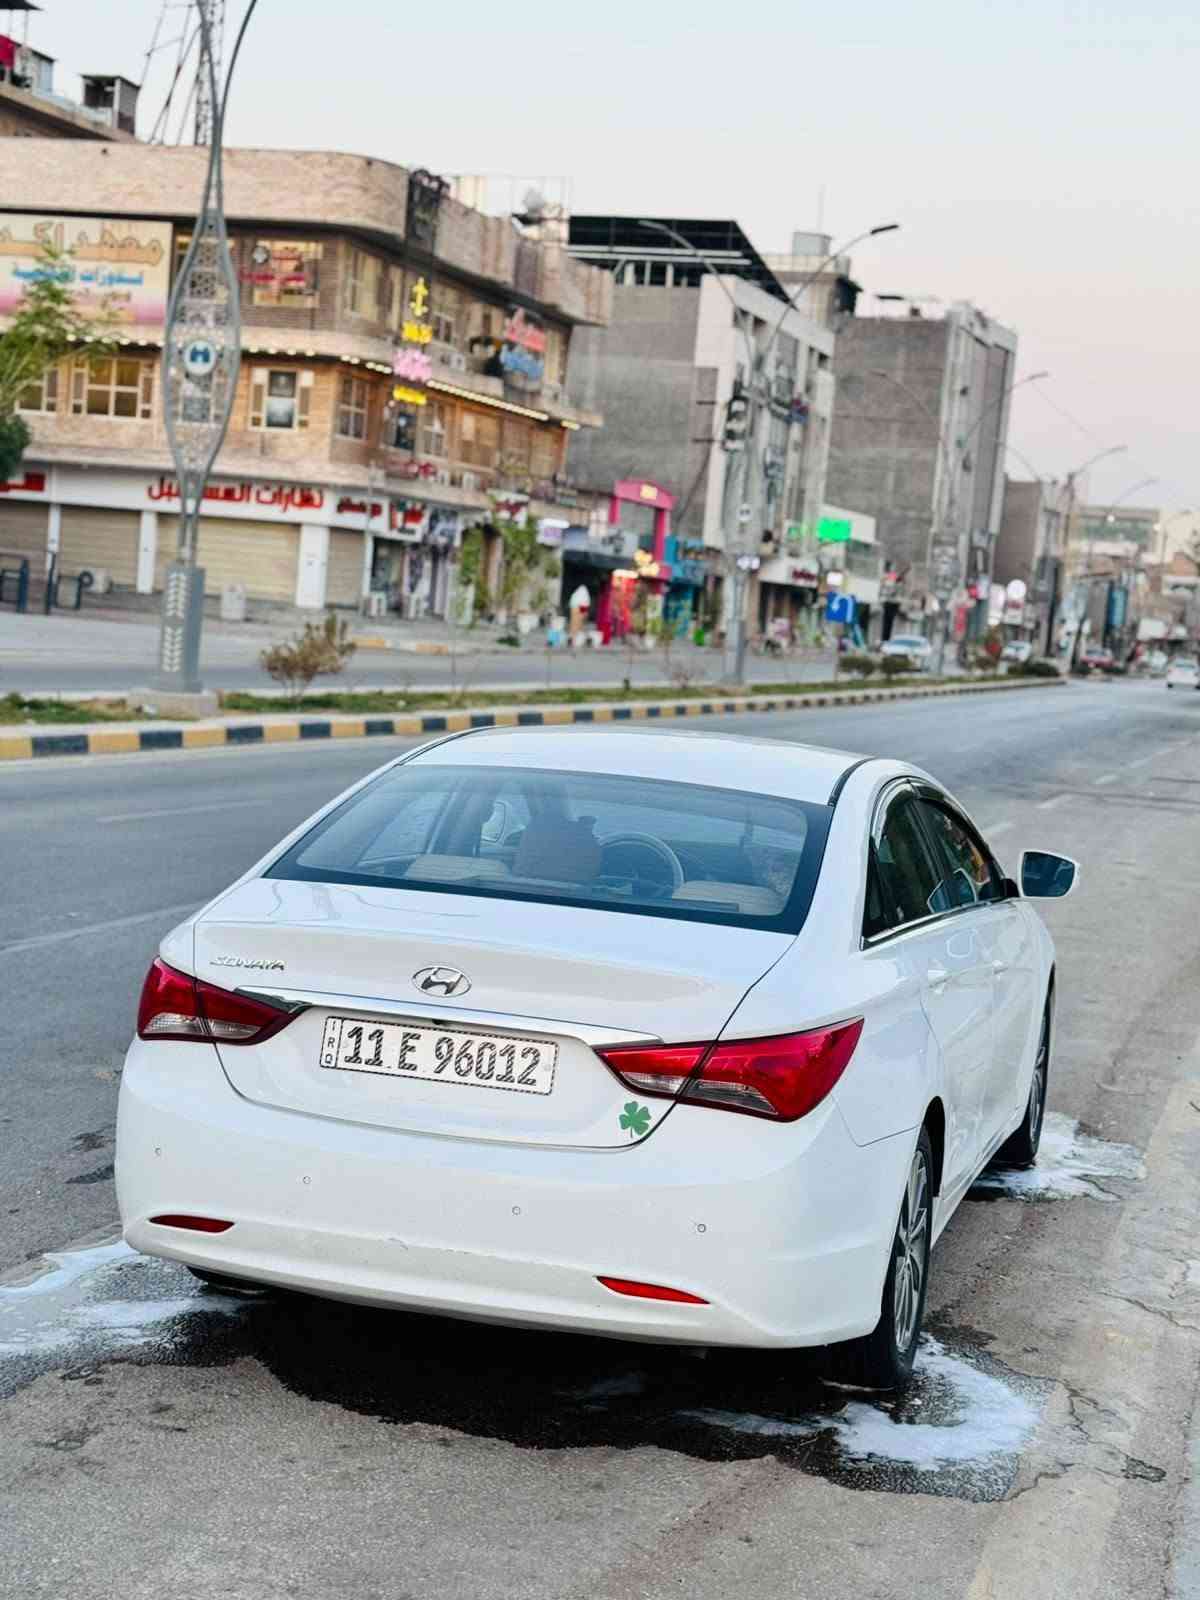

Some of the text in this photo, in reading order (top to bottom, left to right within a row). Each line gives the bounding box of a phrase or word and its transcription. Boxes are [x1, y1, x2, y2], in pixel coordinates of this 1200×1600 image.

[343, 1026, 542, 1087] 11 E 96012
